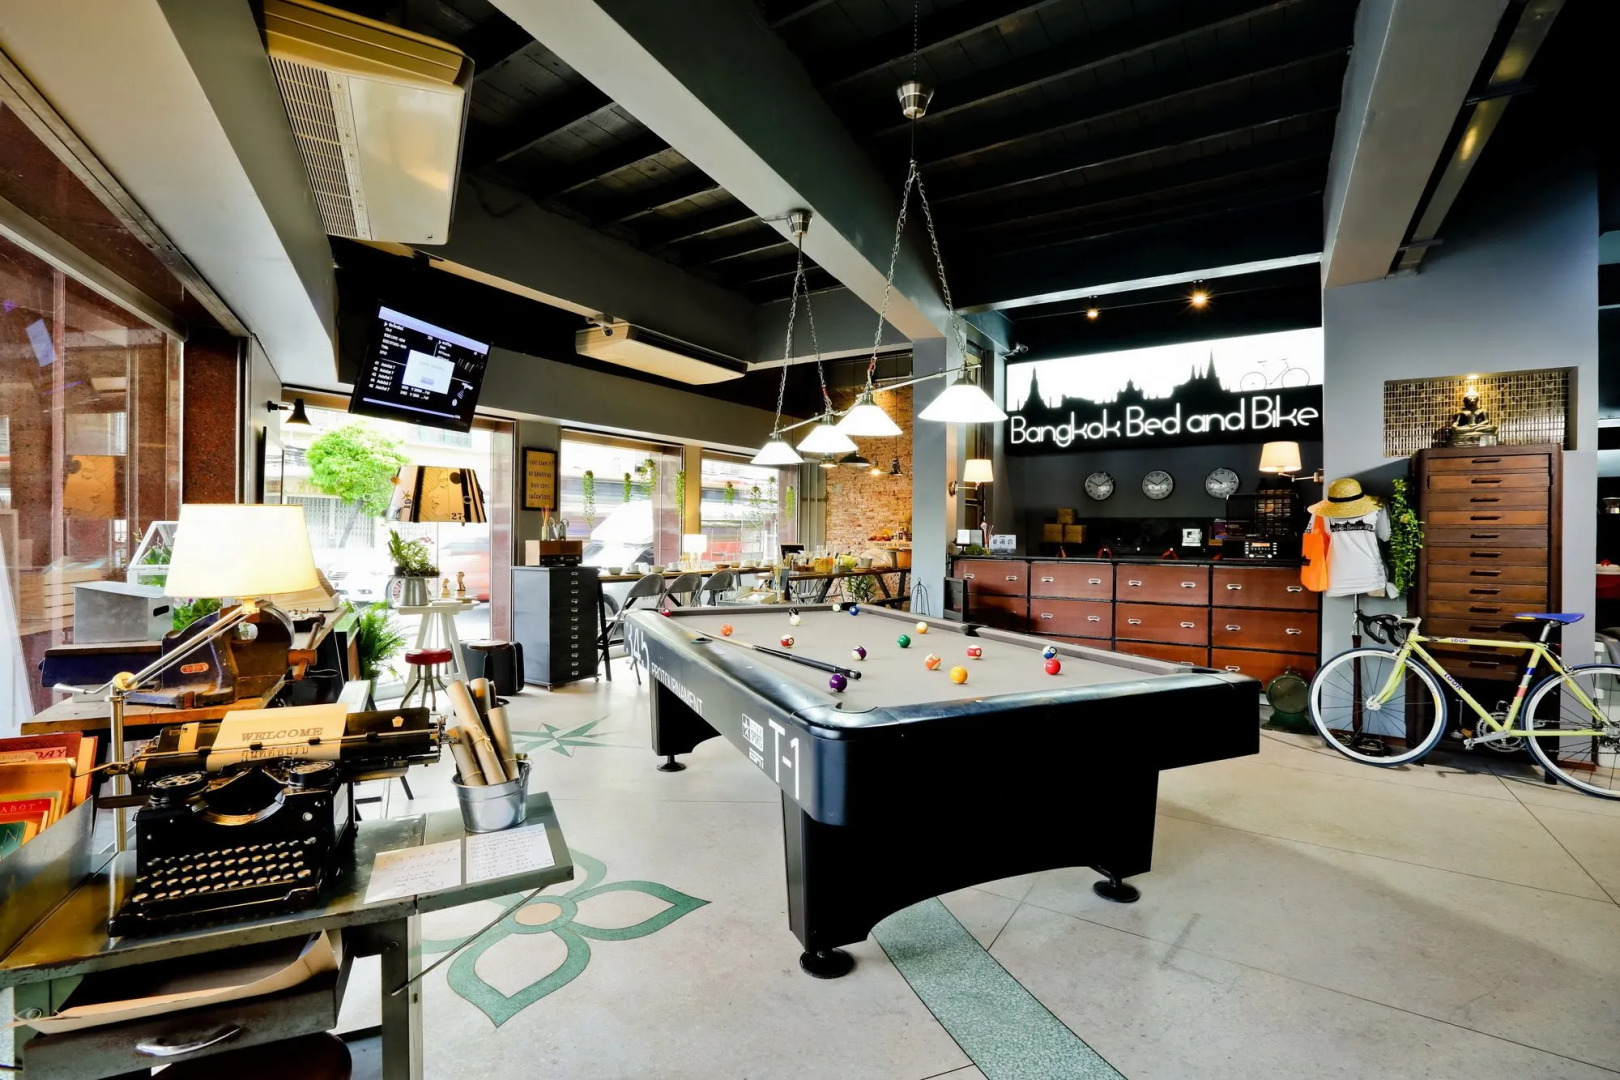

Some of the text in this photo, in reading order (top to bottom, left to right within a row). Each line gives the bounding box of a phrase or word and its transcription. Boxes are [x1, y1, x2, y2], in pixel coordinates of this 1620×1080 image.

[1010, 394, 1320, 448] Bangkok Bed and Bike
[1443, 673, 1463, 690] LOOK
[241, 727, 324, 742] WELCOME
[768, 717, 800, 801] T-1
